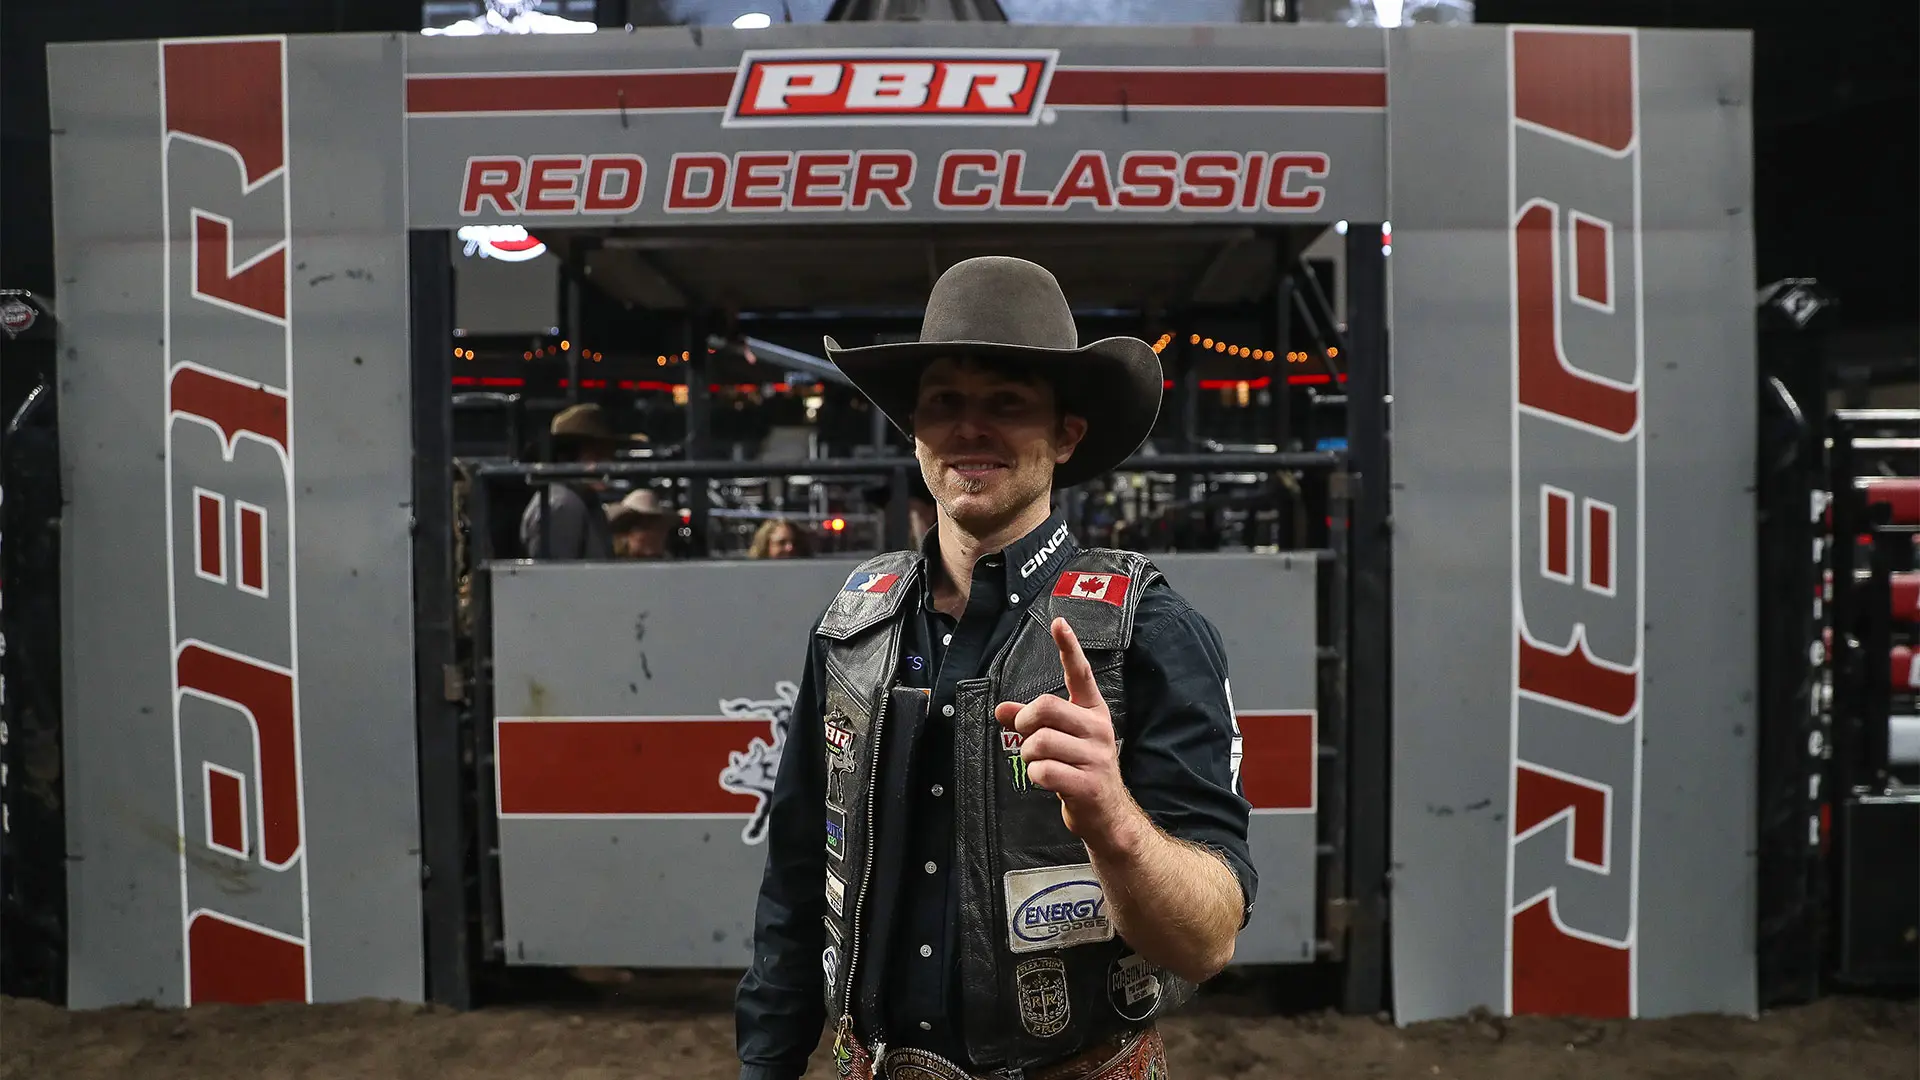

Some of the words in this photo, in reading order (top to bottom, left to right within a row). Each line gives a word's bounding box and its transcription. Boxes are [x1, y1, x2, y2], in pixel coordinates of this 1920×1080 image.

[752, 62, 1029, 110] PBR
[459, 153, 648, 218] RED
[662, 149, 918, 214] DEER
[934, 149, 1331, 214] CLASSIC
[163, 128, 308, 944] PBR
[1510, 120, 1642, 948] PBR
[1024, 898, 1103, 926] ENERGY
[1047, 917, 1108, 934] DODGE
[1031, 1021, 1064, 1035] PRO
